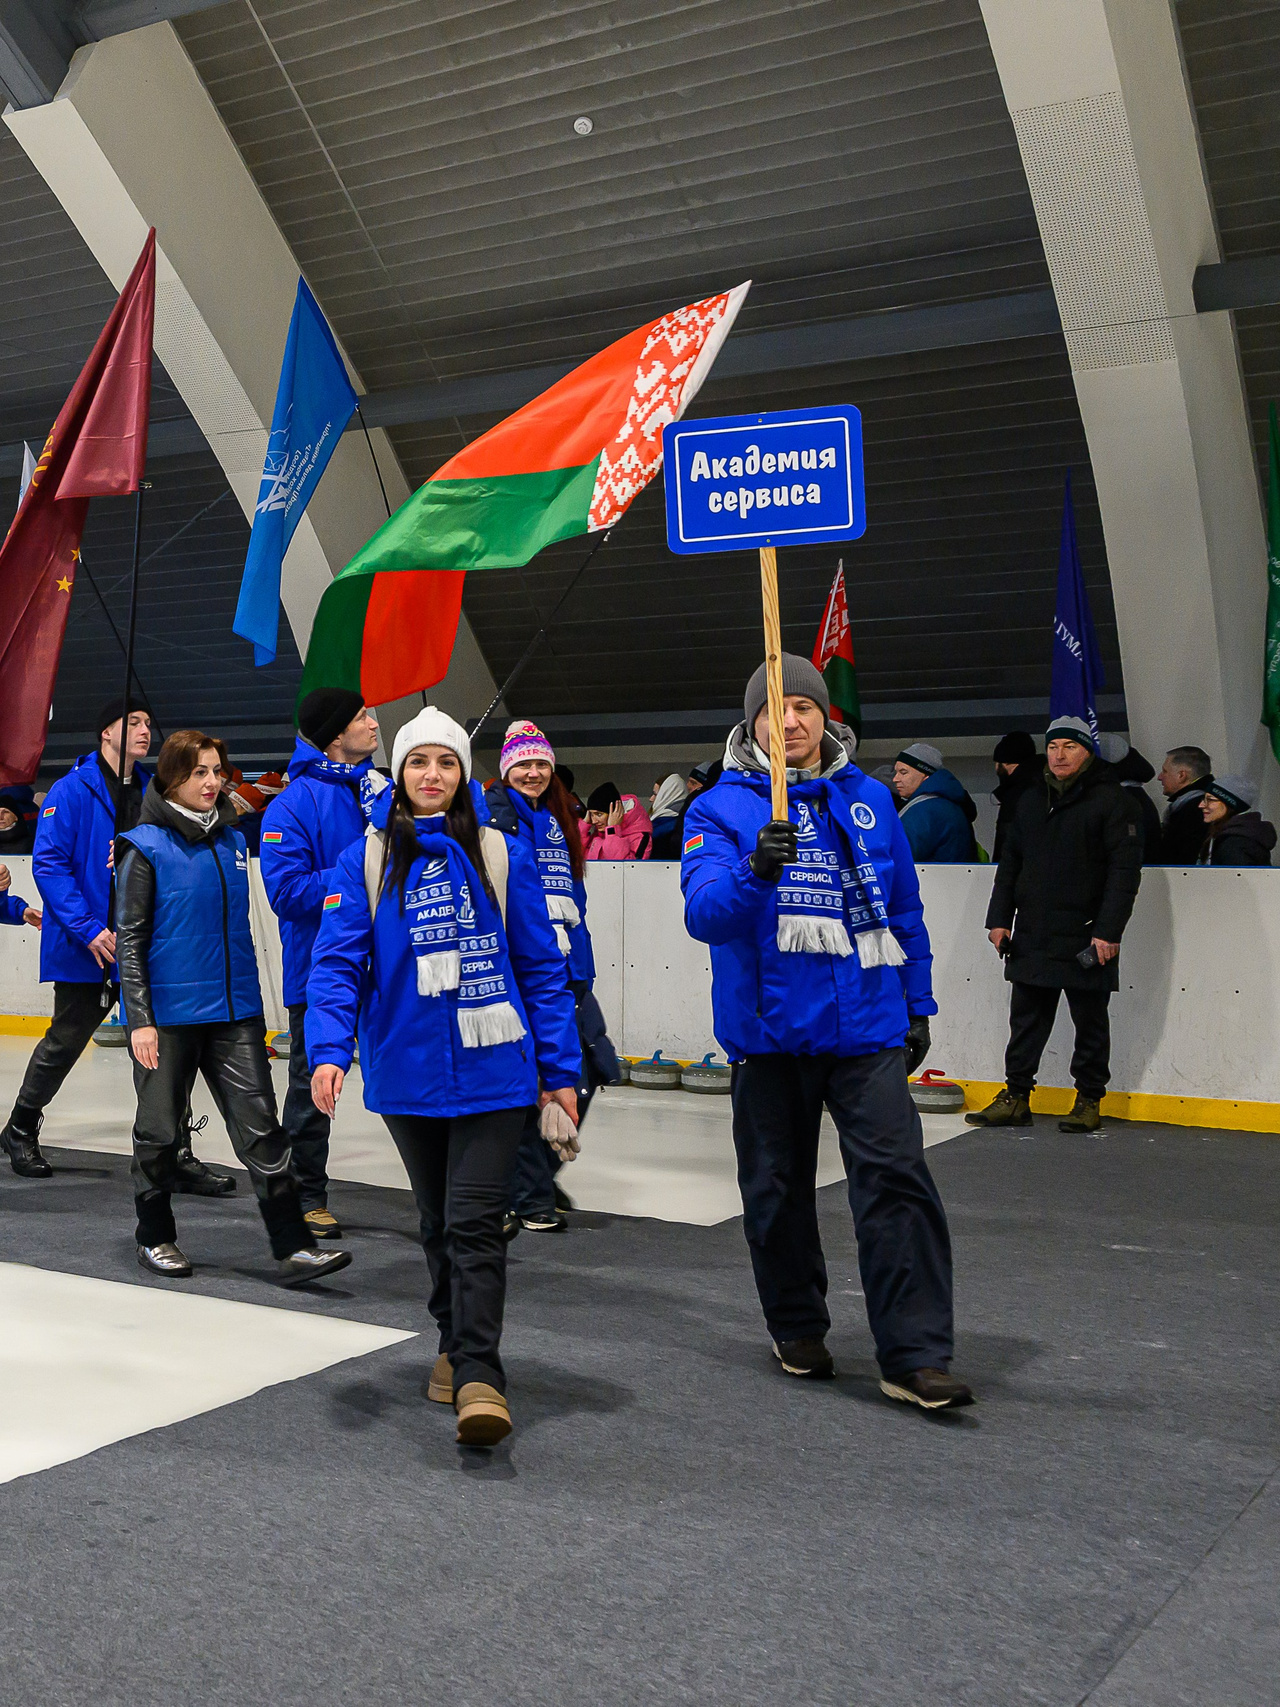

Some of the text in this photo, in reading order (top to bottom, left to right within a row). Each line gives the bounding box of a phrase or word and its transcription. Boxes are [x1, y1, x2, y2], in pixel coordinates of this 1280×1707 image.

[689, 444, 837, 483] Академия
[708, 483, 821, 519] сервиса
[789, 871, 833, 885] СЕРВИСА
